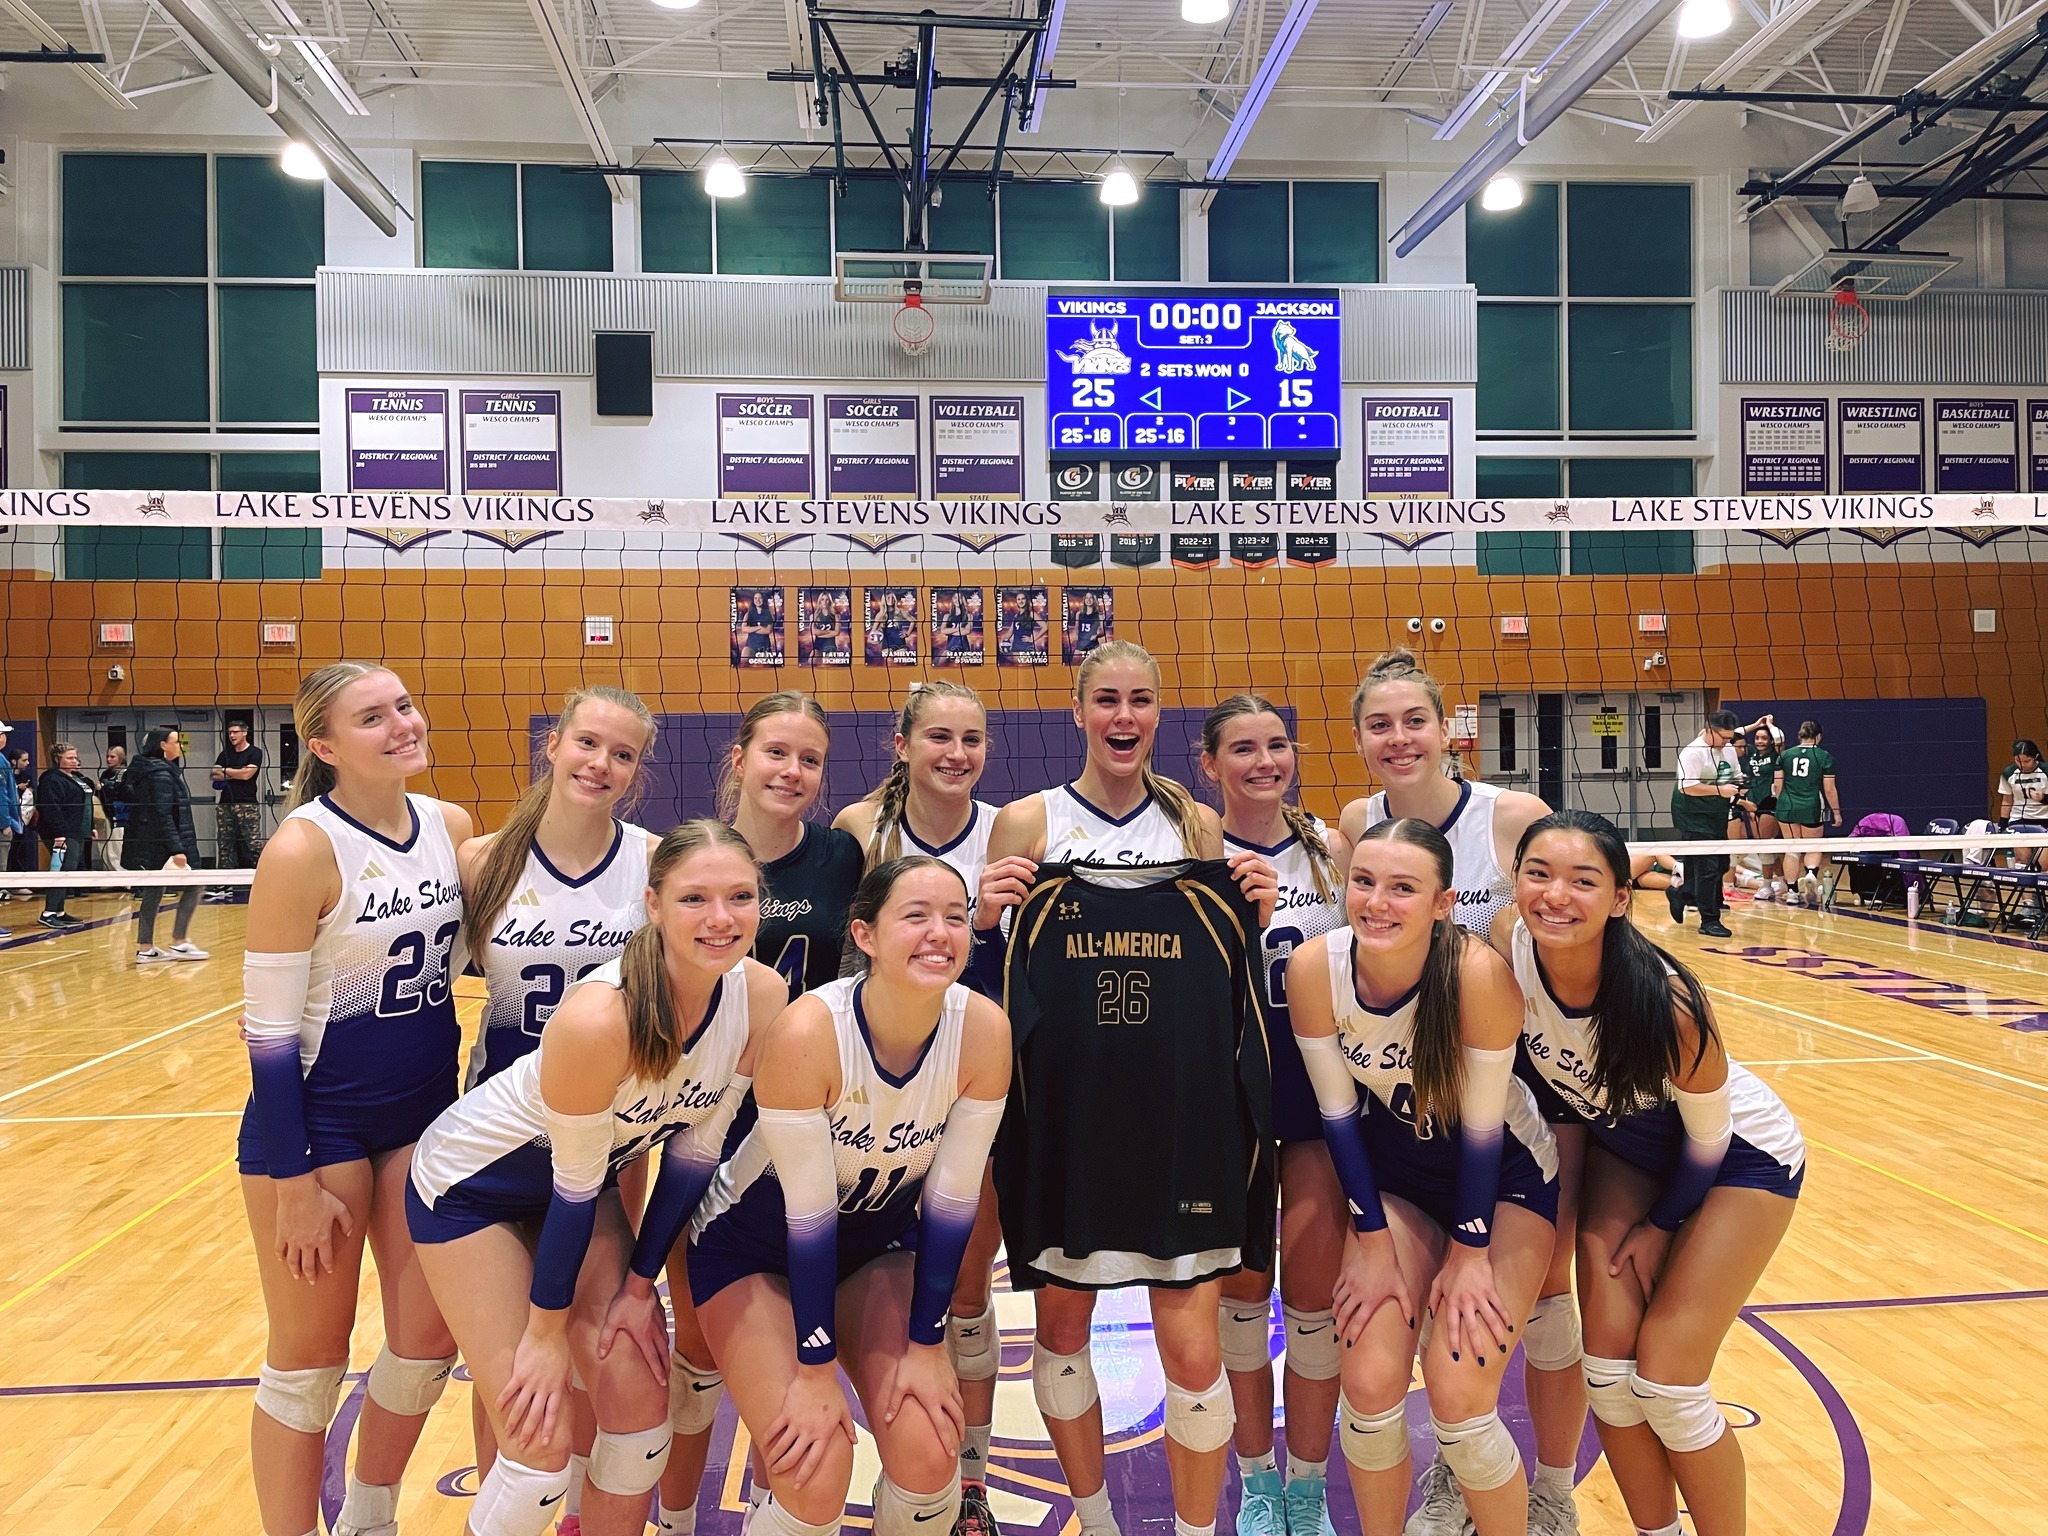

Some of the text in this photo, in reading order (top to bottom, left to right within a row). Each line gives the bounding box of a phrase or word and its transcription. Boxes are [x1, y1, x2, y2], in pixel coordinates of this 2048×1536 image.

[1058, 302, 1127, 314] VIKINGS
[1256, 303, 1334, 316] JACKSON
[1150, 303, 1242, 330] 00:00
[1205, 335, 1212, 344] 3
[1140, 363, 1250, 377] 2 SETS WON 0
[1072, 378, 1115, 408] 25
[1279, 379, 1313, 408] 15
[372, 398, 424, 411] TENNIS
[486, 400, 536, 412] TENNIS
[738, 404, 792, 416] SOCCER
[846, 405, 898, 416] SOCCER
[938, 406, 1016, 416] VOLLEYBALL
[1374, 406, 1441, 418] FOOTBALL
[1750, 406, 1822, 418] WRESTLING
[1846, 407, 1918, 418] WRESTLING
[1942, 409, 2010, 419] BASKETBALL
[870, 420, 900, 428] CHAMPS
[1084, 416, 1090, 426] 1
[1156, 416, 1164, 426] 2
[1228, 416, 1236, 426] 3
[1298, 416, 1305, 426] 4
[1061, 428, 1112, 444] 25-18
[1135, 428, 1186, 444] 25-16
[730, 456, 762, 464] DISTRICT
[216, 493, 594, 522] LAKE STEVENS VIKINGS
[711, 501, 1062, 526] LAKE STEVENS VIKINGS
[1171, 502, 1506, 525] LAKE STEVENS VIKINGS
[1611, 496, 1935, 522] LAKE STEVENS VIKINGS
[1119, 538, 1136, 546] 2016
[1081, 623, 1091, 632] 13
[1792, 757, 1810, 778] 13
[356, 887, 414, 924] Lake
[1274, 886, 1339, 912] Steves
[490, 918, 634, 948] Lake Steve
[1103, 931, 1182, 960] AMERICA
[376, 920, 460, 1018] 23
[1097, 970, 1150, 1026] 26
[838, 1165, 908, 1214] 11
